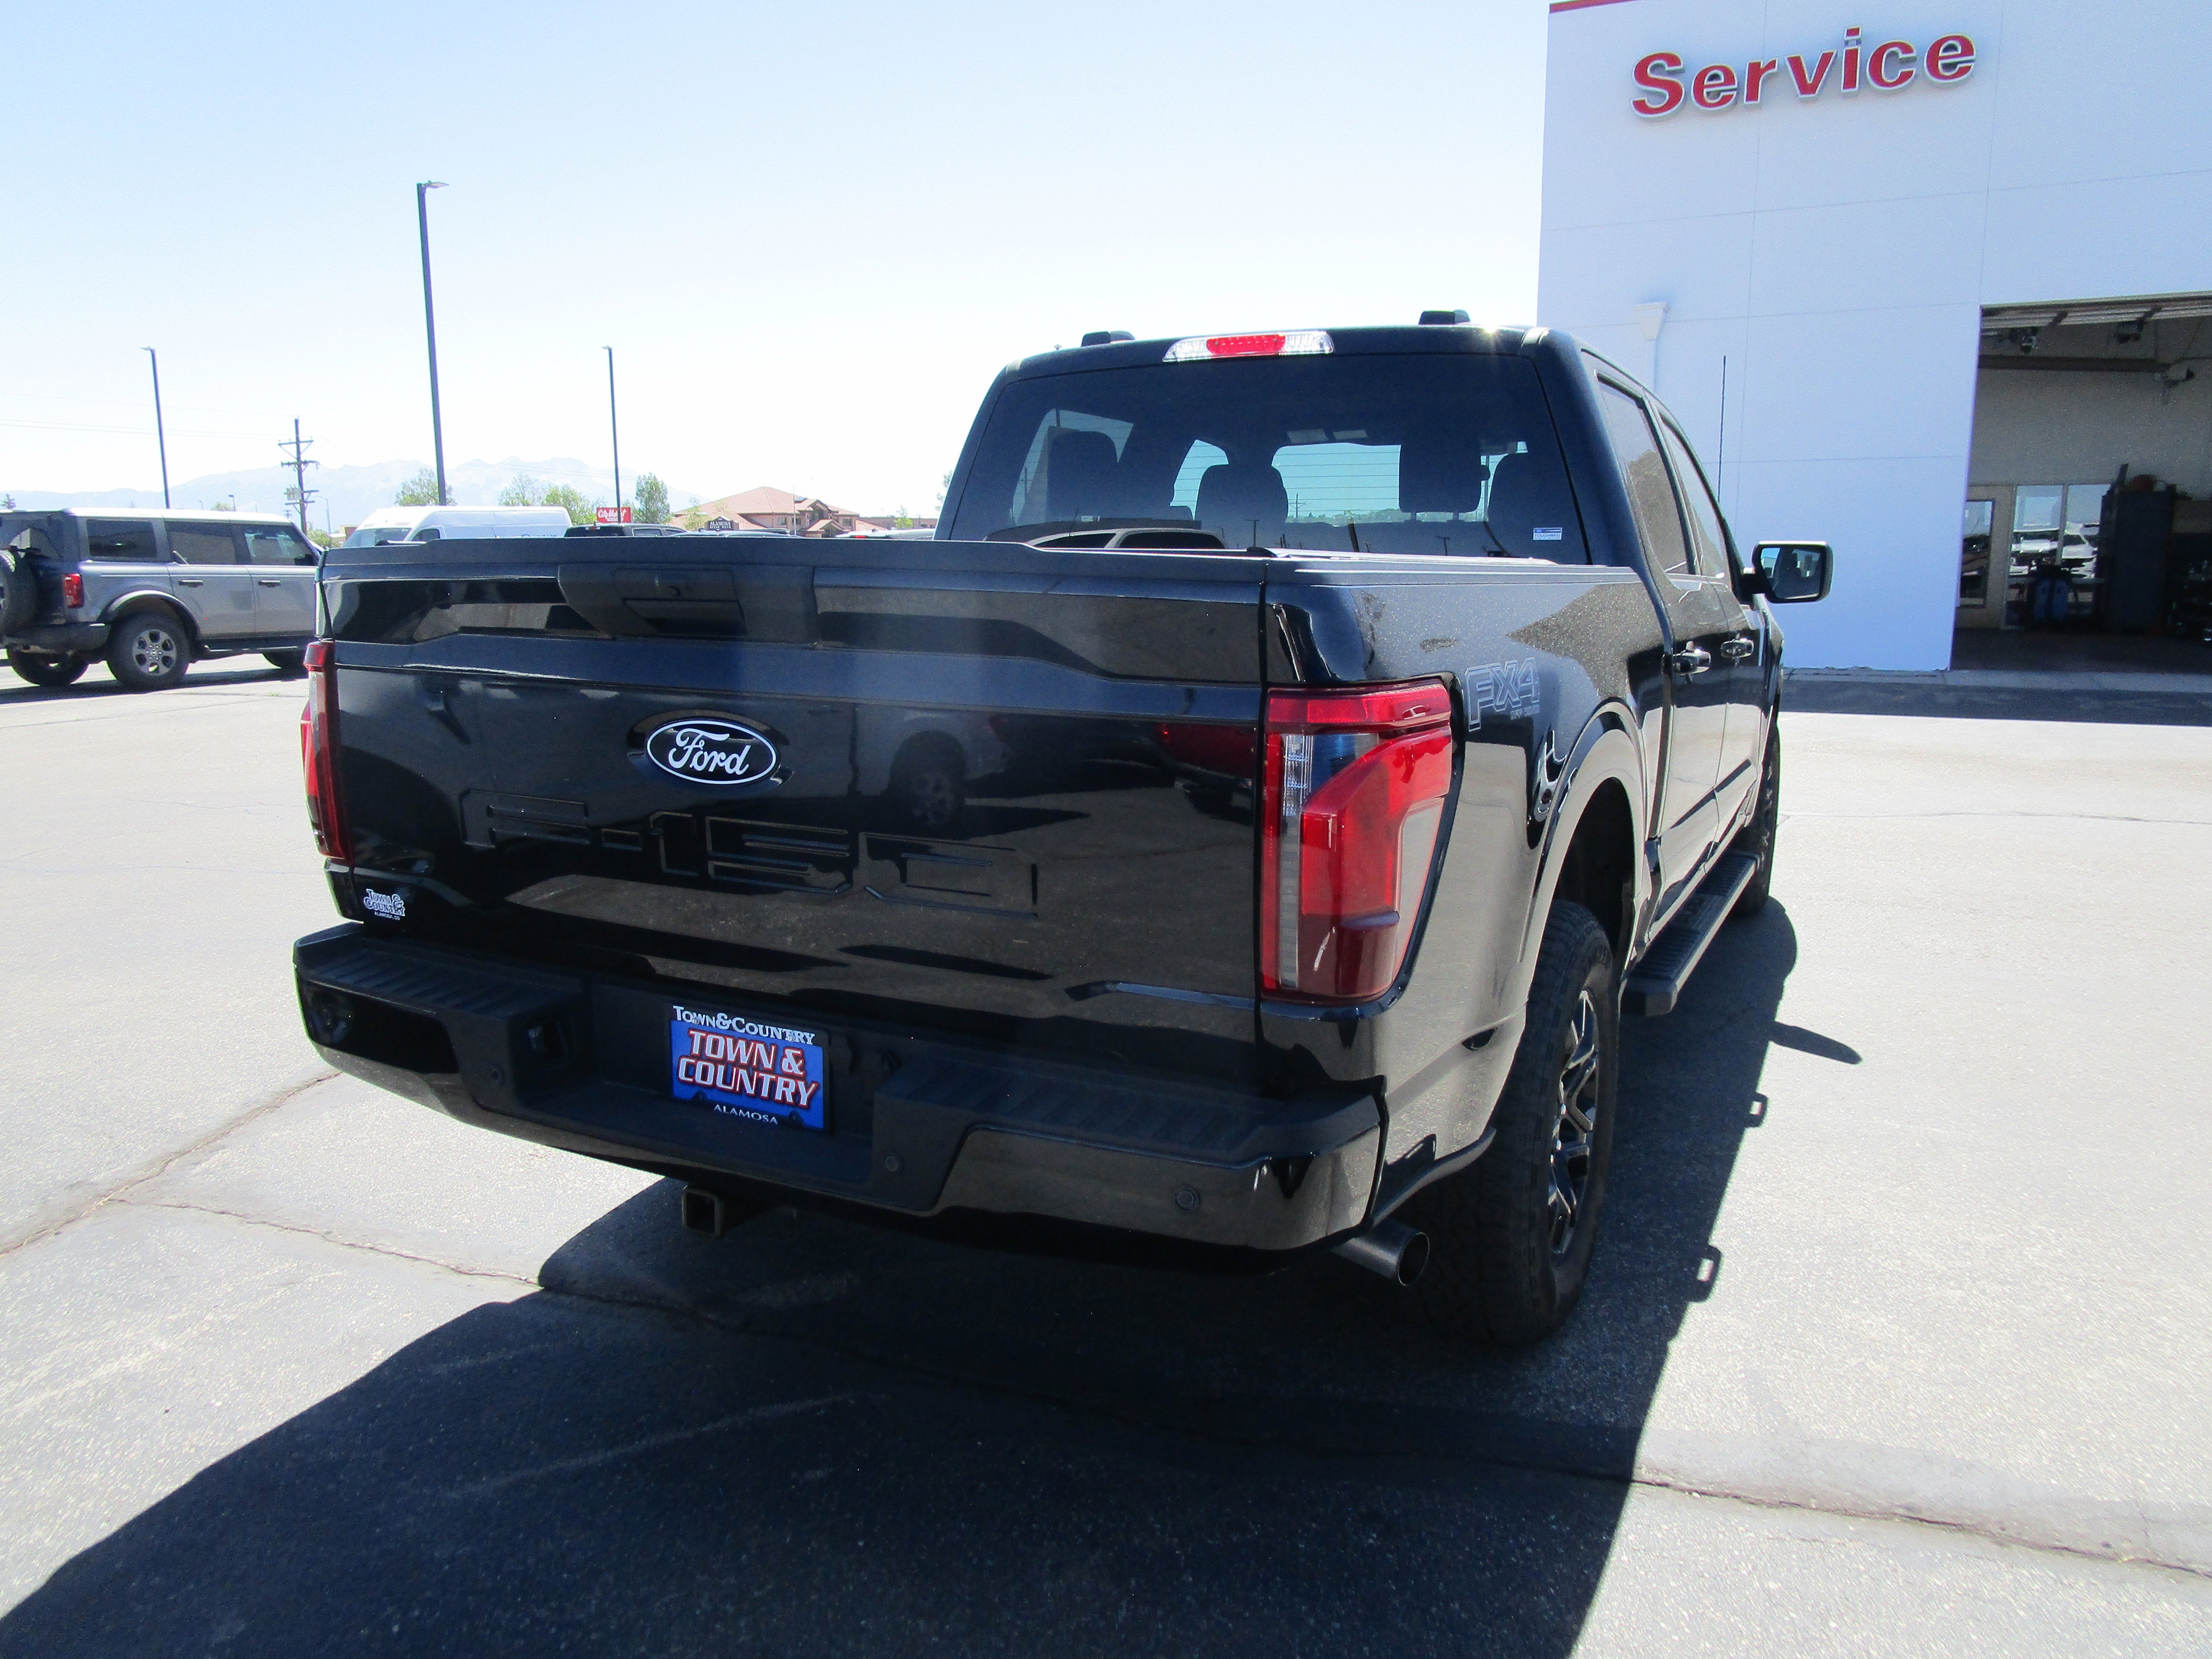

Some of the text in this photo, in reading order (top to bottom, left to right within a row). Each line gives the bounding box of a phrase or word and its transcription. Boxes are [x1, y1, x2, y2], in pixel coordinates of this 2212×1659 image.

[1631, 26, 1976, 119] Service
[1465, 656, 1539, 732] FX4
[668, 728, 751, 775] Ford
[688, 1028, 805, 1077] TOWN &
[678, 1056, 819, 1109] COUNTRY
[714, 1104, 778, 1125] ALAMOSA
